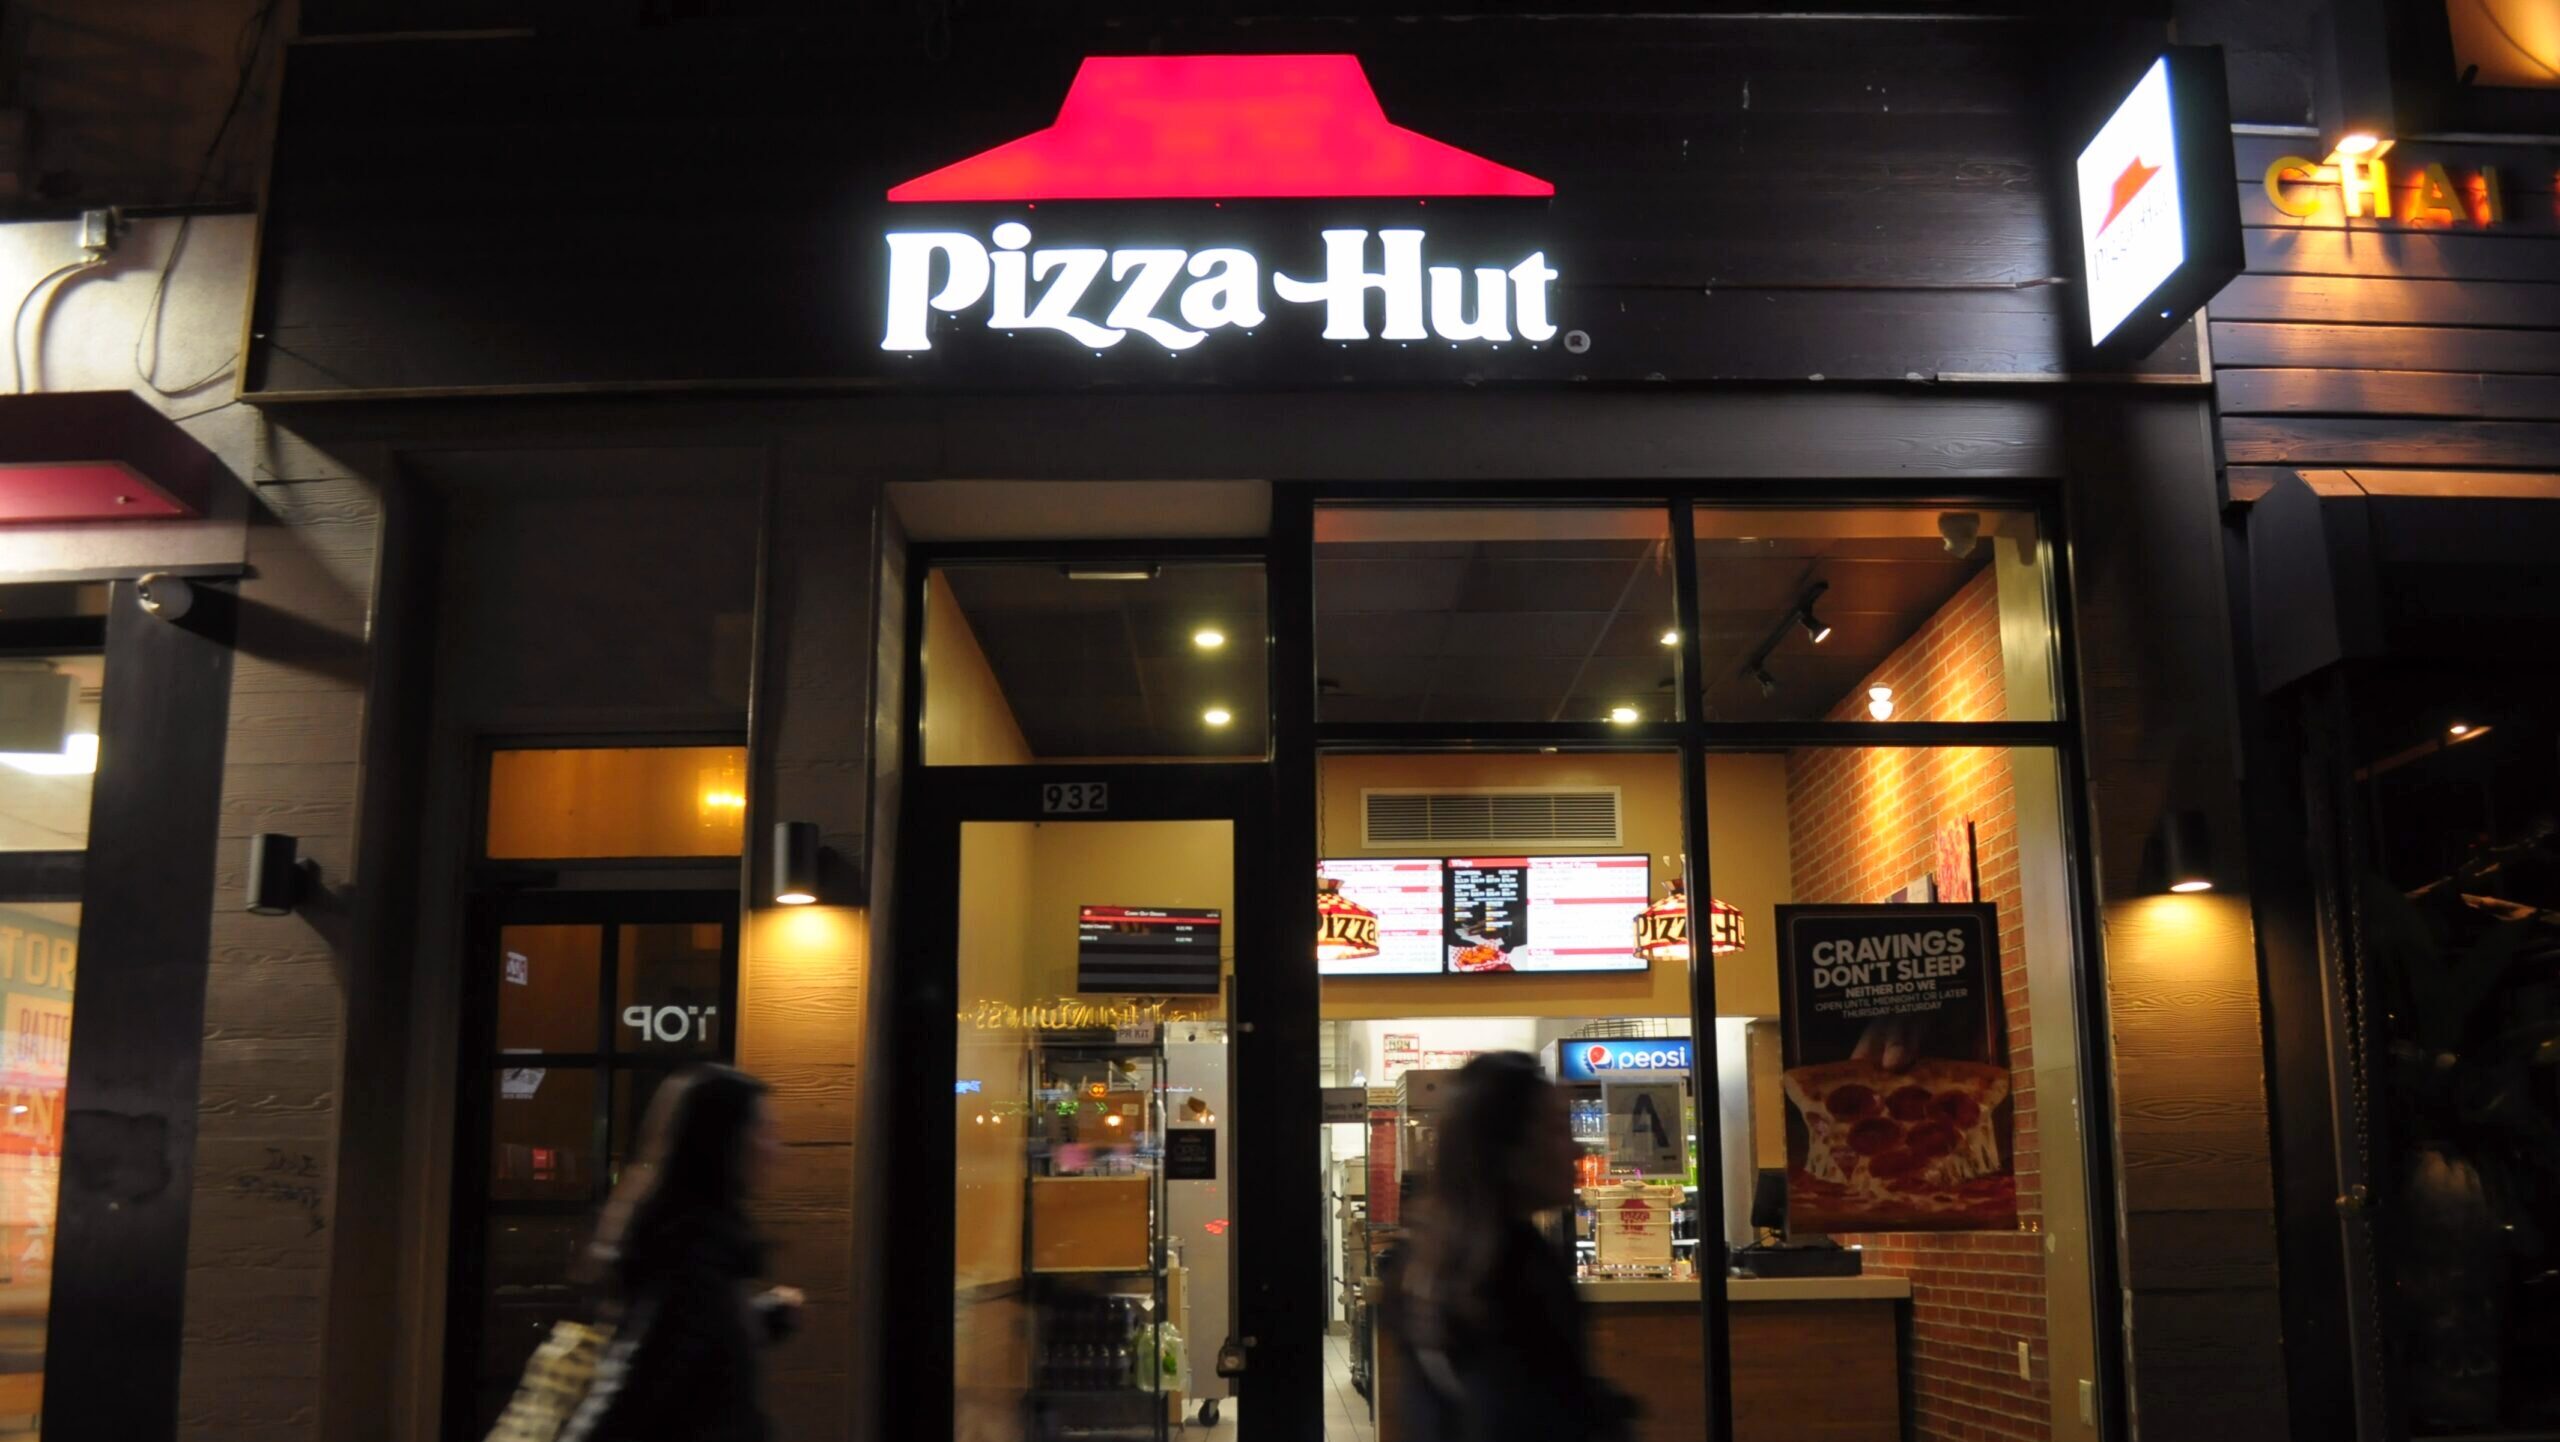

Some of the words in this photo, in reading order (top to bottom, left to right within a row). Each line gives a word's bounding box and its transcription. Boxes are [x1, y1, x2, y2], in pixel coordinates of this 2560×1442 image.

[2264, 156, 2497, 223] CHAI
[881, 222, 1266, 351] Pizza
[1274, 228, 1559, 342] Hut
[1046, 783, 1105, 811] 932
[1317, 911, 1377, 950] izza
[1812, 928, 1965, 967] CRAVINGS
[1813, 961, 1891, 989] DON'T
[1897, 954, 1966, 982] SLEEP
[1845, 983, 1893, 998] NEITHER
[1896, 982, 1915, 994] DO
[1917, 979, 1936, 991] WE
[1815, 1001, 1842, 1012] OPEN
[1844, 998, 1871, 1010] UNTIL
[1873, 994, 1921, 1007] MIDNIGHT
[1923, 991, 1937, 1002] OR
[1939, 988, 1968, 1000] LATER
[1618, 1045, 1686, 1069] pepsi
